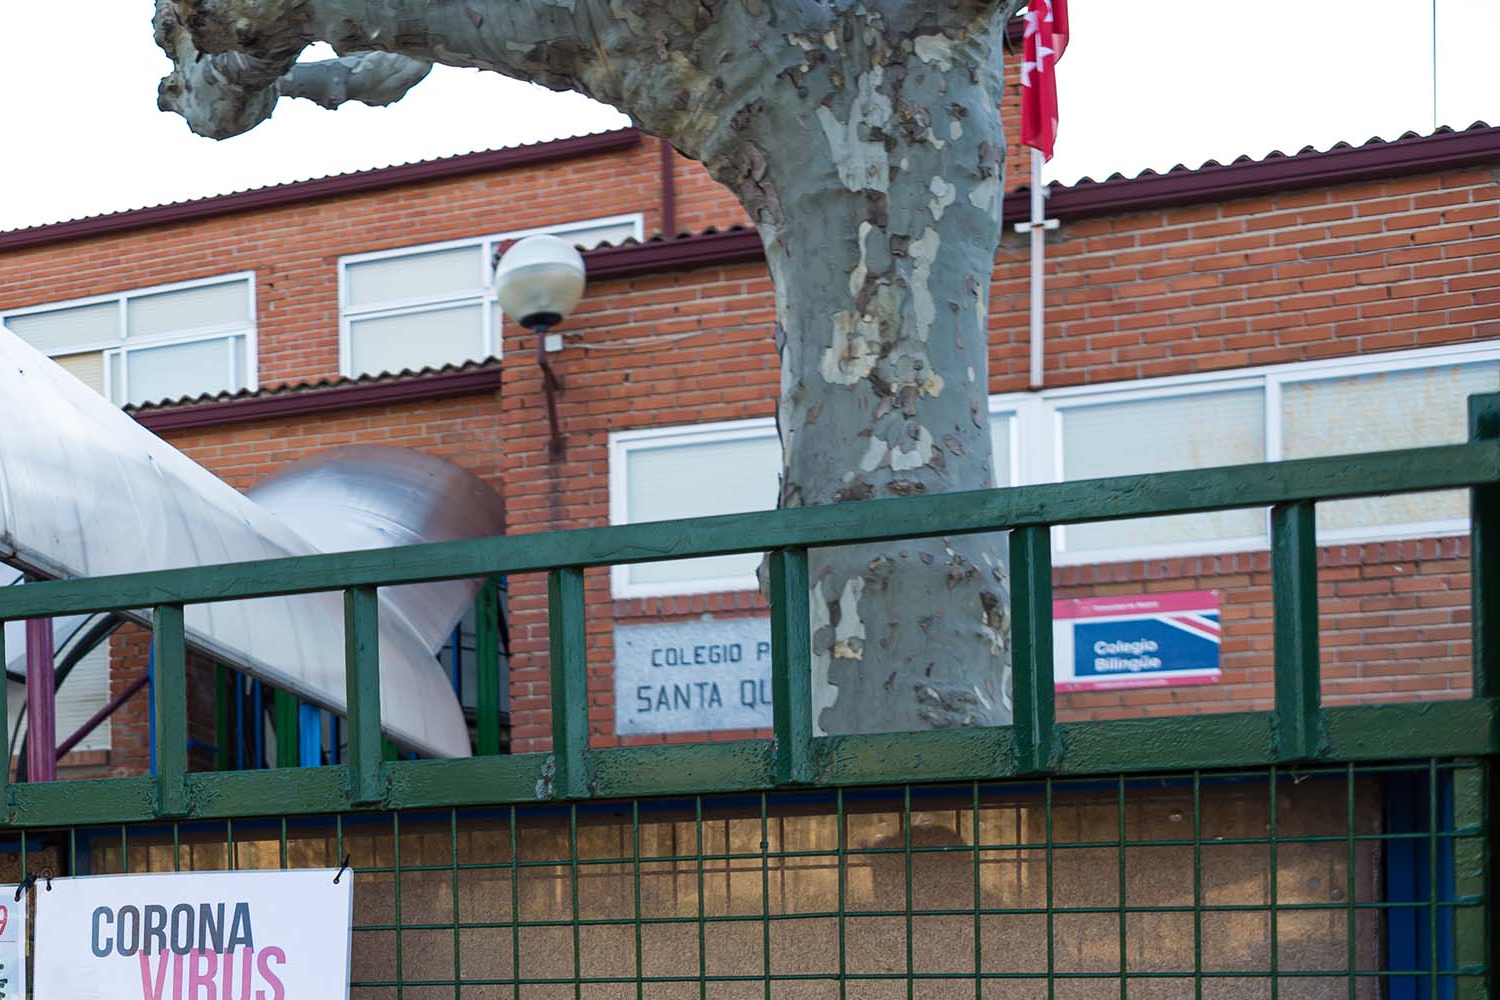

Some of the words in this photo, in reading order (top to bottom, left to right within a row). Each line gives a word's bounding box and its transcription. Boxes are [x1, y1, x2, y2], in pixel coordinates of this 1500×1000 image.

[651, 642, 742, 667] COLEGIO
[1093, 638, 1158, 655] Colegio
[1094, 655, 1162, 672] Bilingüe
[636, 682, 723, 712] SANTA
[91, 902, 255, 958] CORONA
